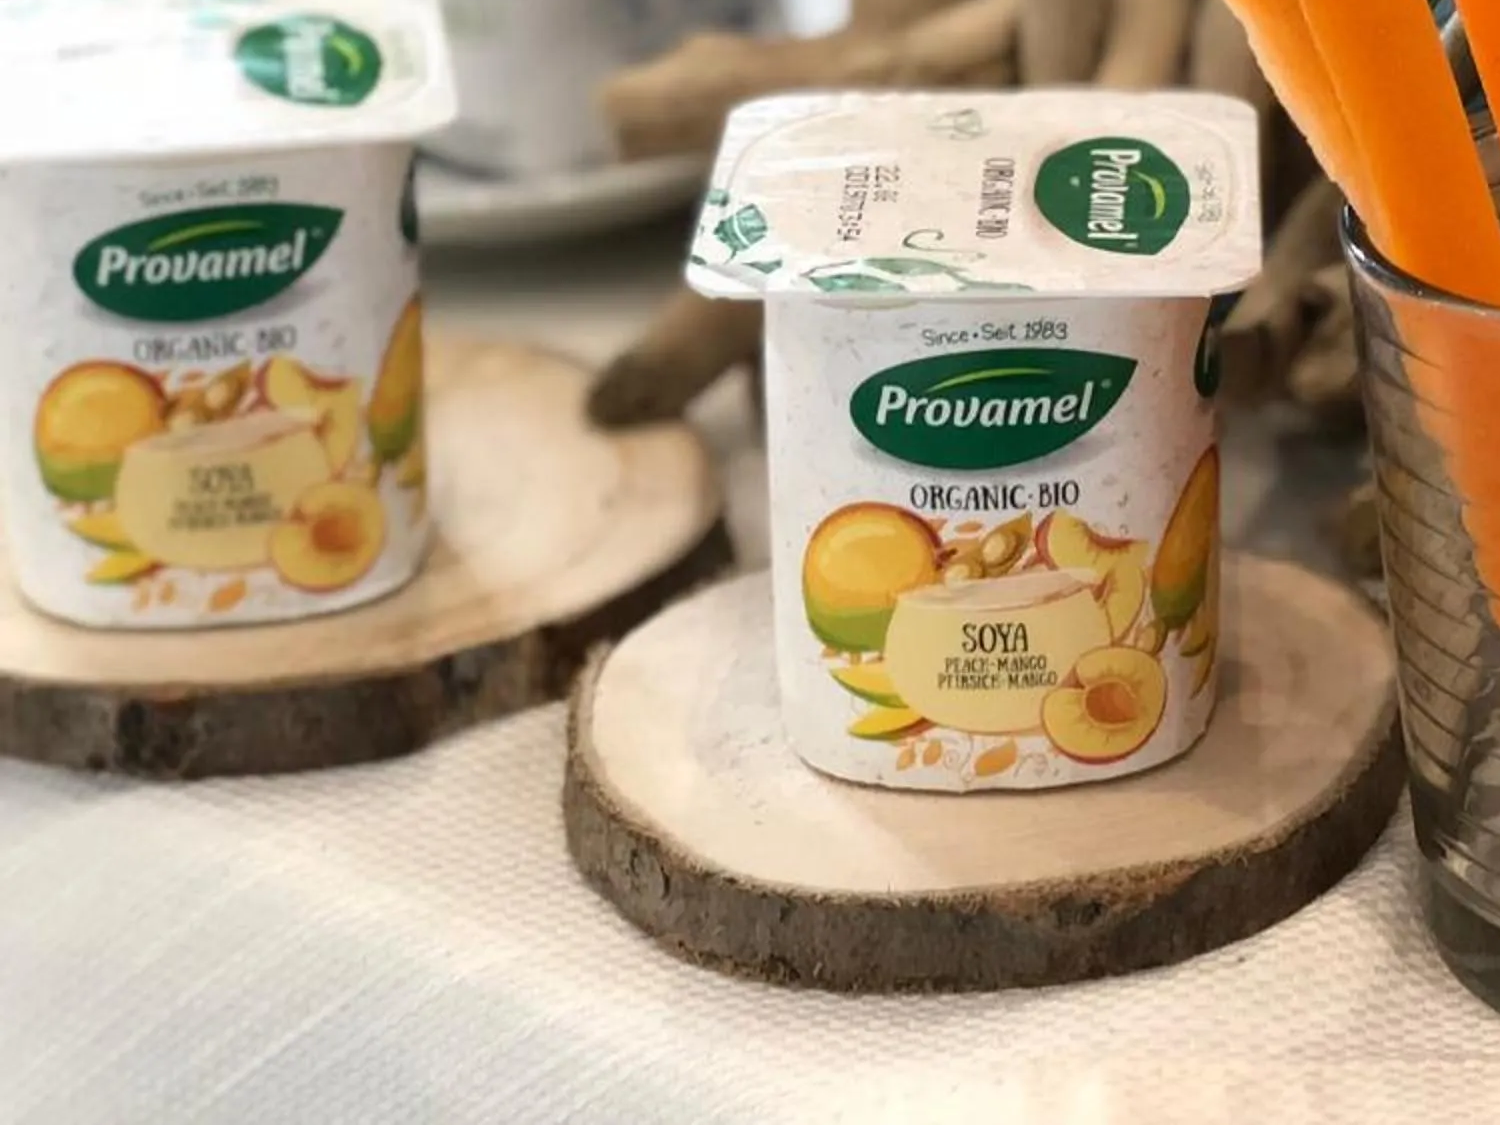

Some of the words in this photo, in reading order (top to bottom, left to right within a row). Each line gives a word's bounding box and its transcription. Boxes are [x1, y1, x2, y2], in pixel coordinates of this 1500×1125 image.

[1088, 149, 1142, 239] Provamel
[97, 227, 306, 287] Provamel
[1024, 318, 1068, 341] 1983
[875, 380, 1095, 427] Provamel
[961, 621, 1029, 654] SOYA
